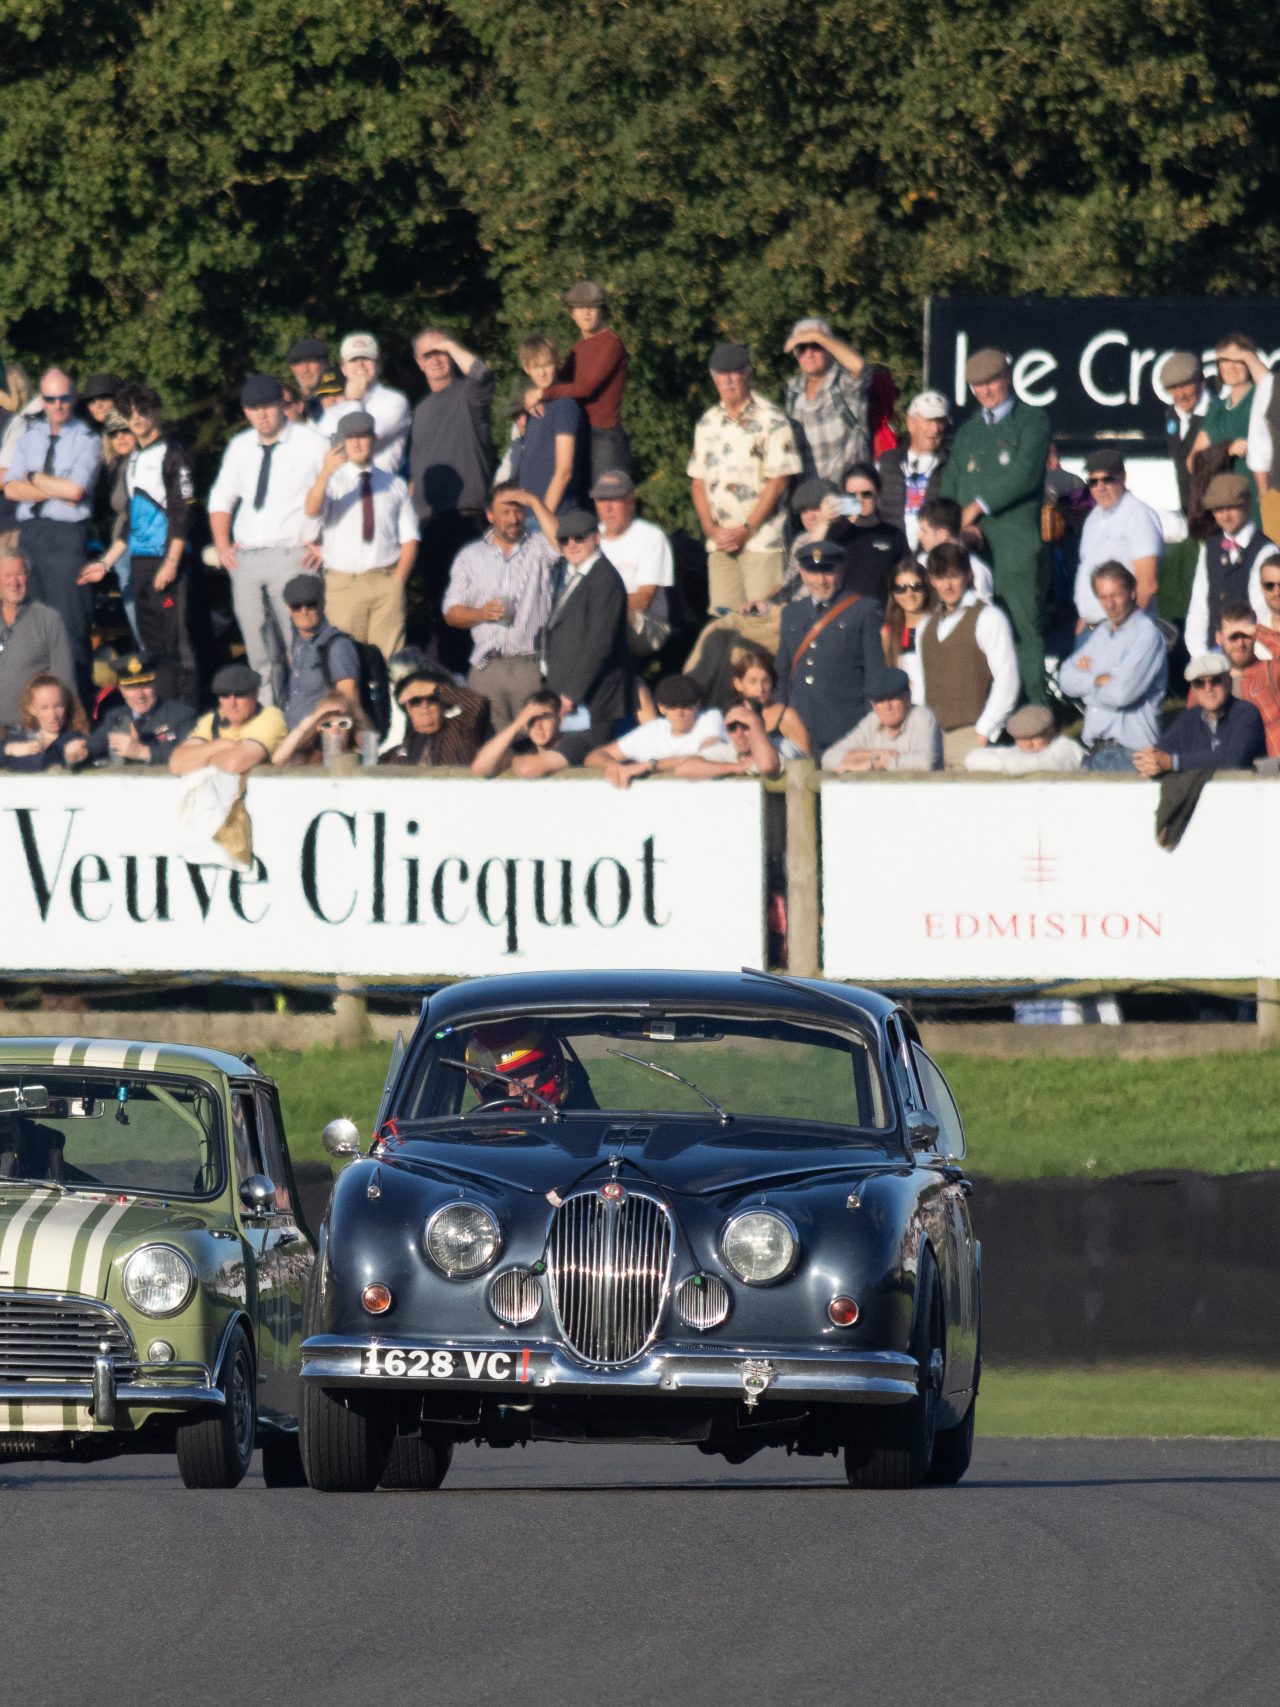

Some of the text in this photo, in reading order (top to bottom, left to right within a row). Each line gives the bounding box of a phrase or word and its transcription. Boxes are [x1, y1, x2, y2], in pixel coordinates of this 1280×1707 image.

[955, 331, 1058, 406] Ie
[3, 807, 670, 956] Veuve Clicquot
[924, 913, 1165, 938] EDMISTON
[364, 1348, 512, 1380] 1628 VC
